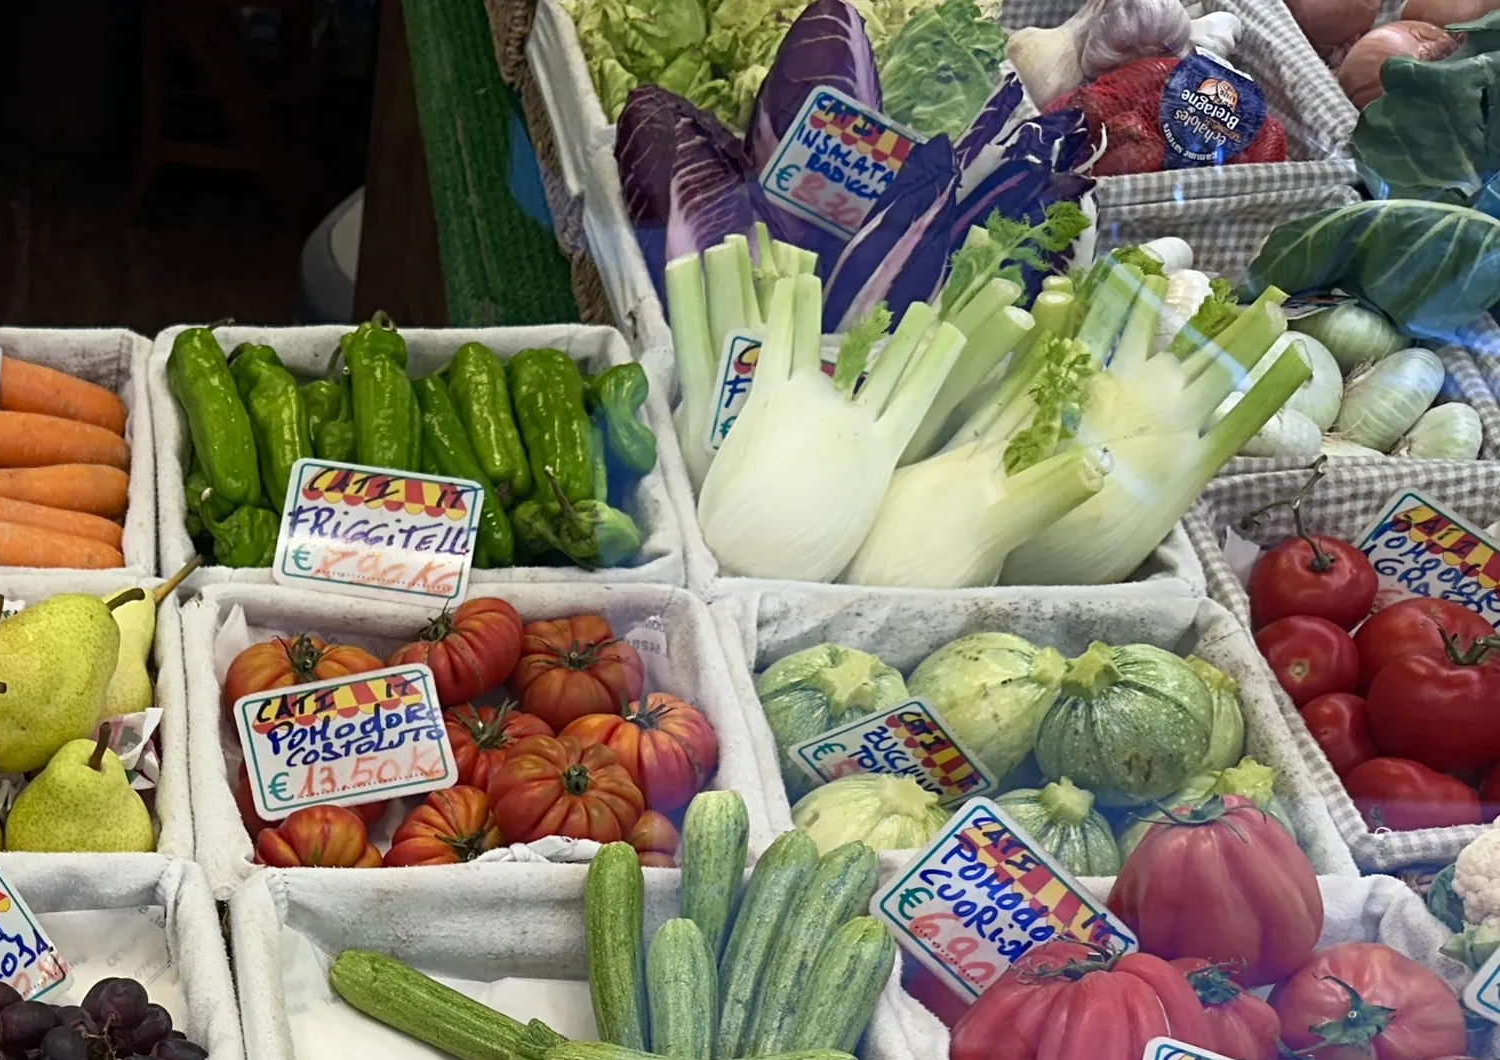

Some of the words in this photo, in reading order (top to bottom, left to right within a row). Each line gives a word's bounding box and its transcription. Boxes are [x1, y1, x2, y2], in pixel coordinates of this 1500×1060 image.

[1181, 89, 1240, 130] Bretagne
[797, 124, 897, 187] INSALATA
[286, 724, 445, 768] COSTOLUTO
[267, 772, 295, 802] €
[897, 886, 936, 921] €
